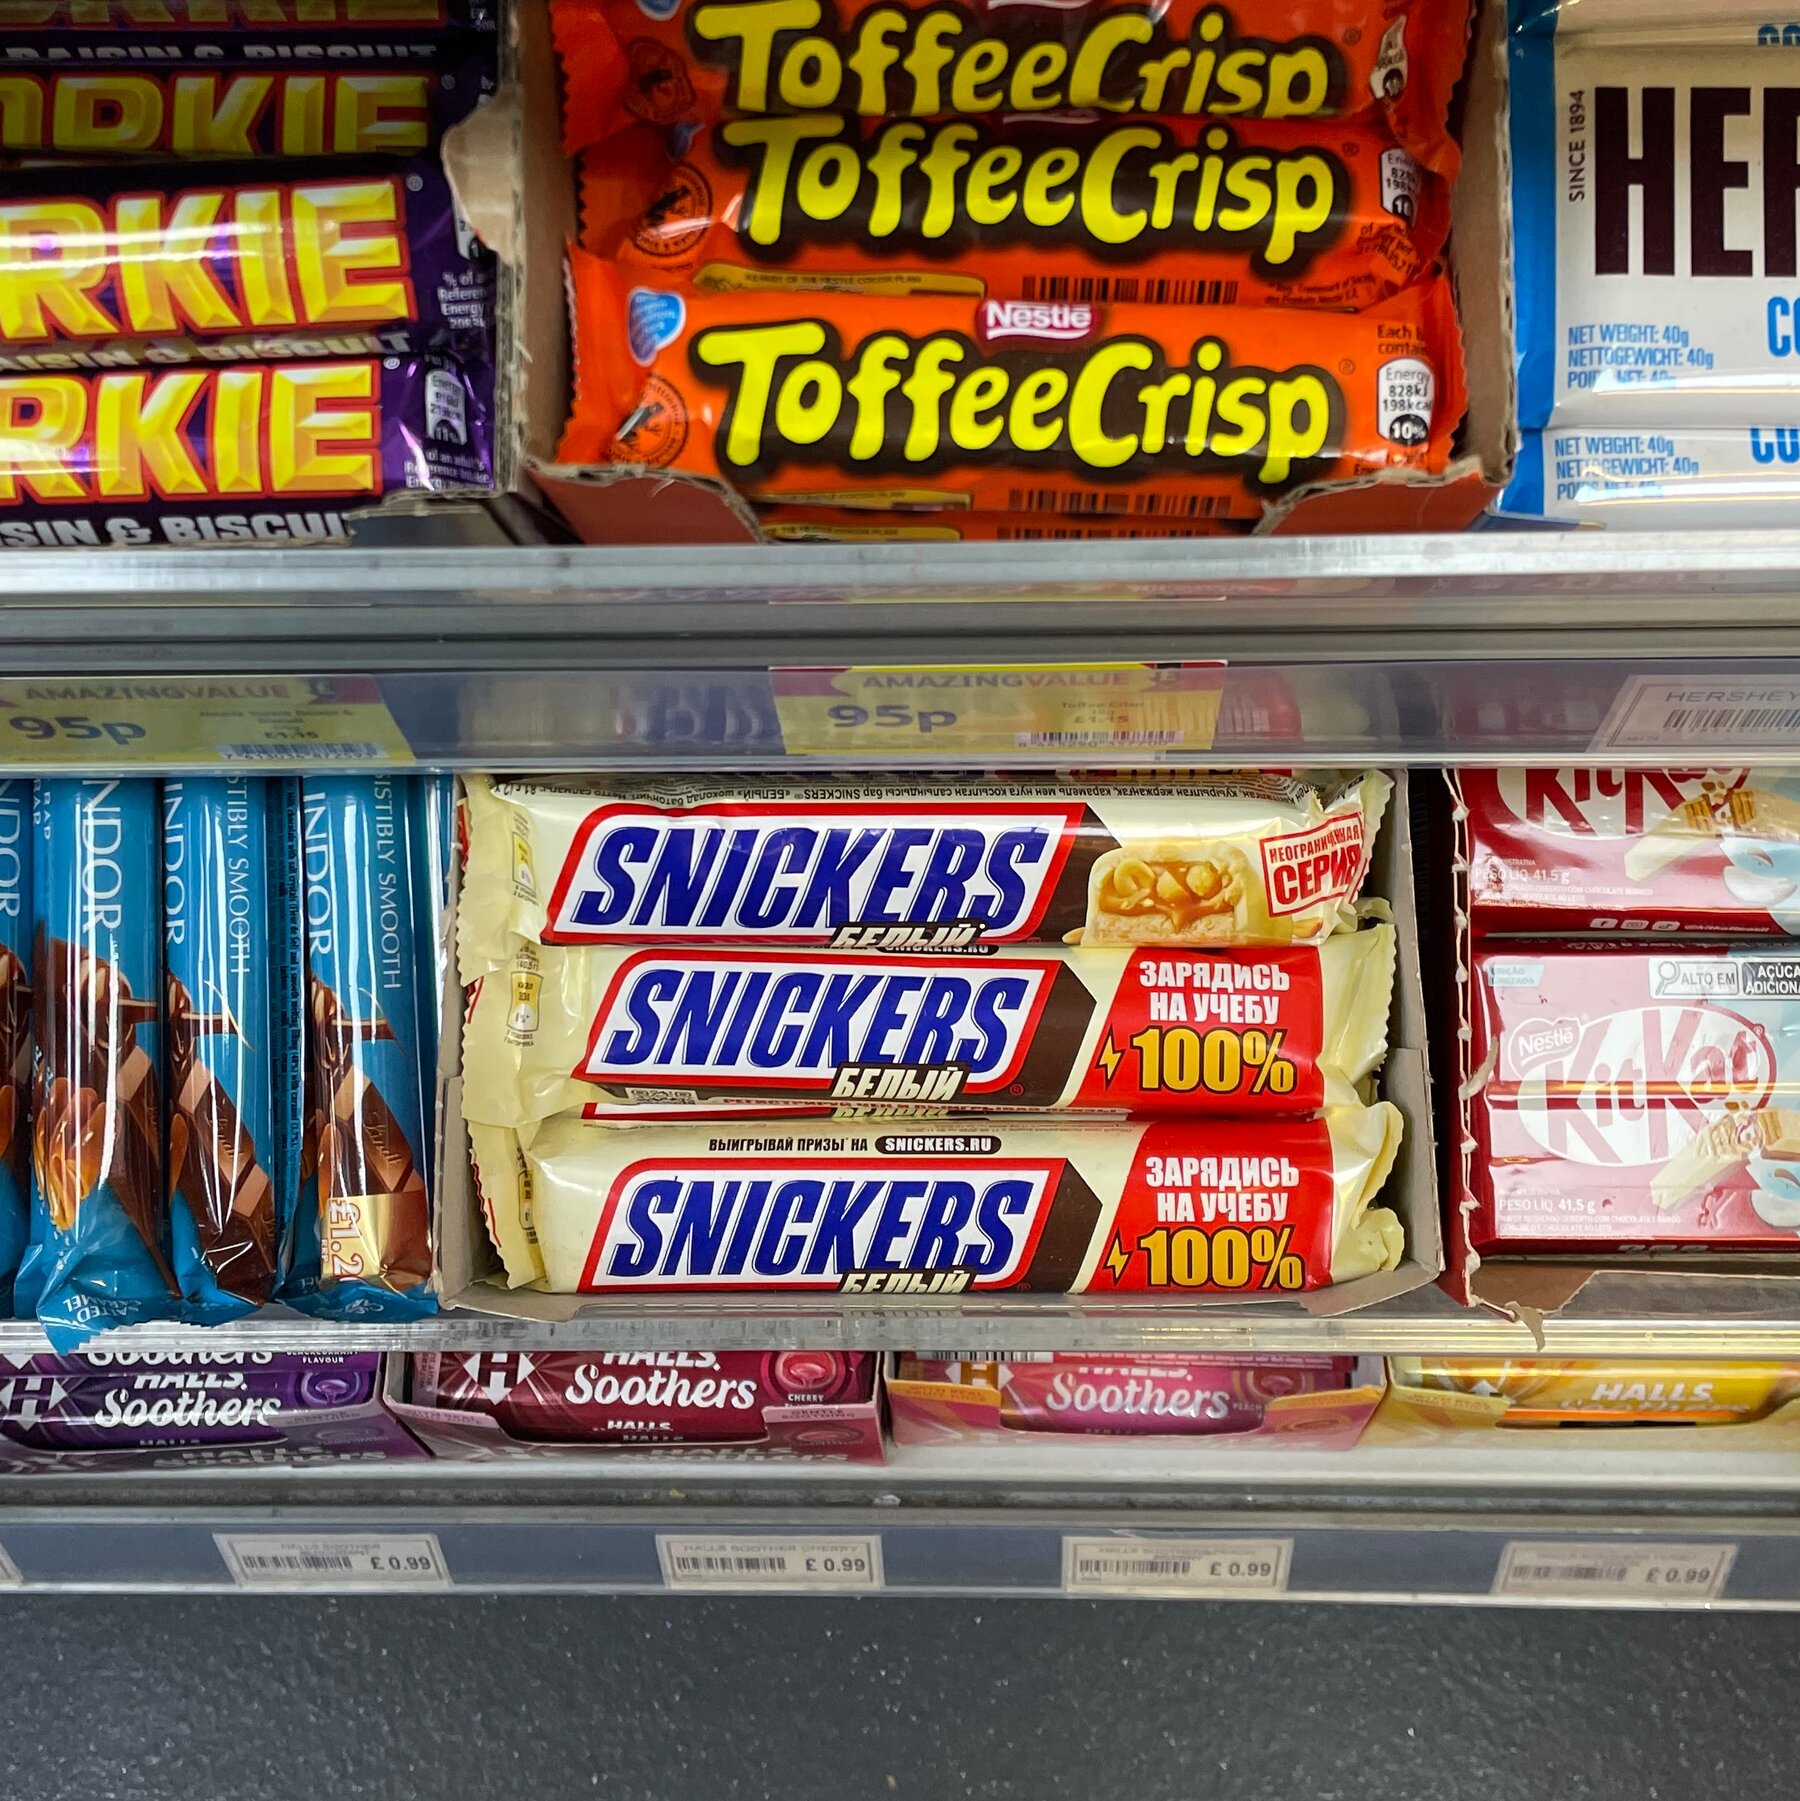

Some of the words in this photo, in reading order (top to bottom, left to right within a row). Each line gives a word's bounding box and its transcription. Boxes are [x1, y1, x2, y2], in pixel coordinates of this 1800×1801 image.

[1569, 90, 1586, 133] 1894
[1569, 140, 1586, 202] SINCE
[1377, 324, 1412, 340] Each
[1567, 325, 1596, 346] NET
[1600, 324, 1659, 344] WEIGHT:
[1662, 326, 1689, 346] 40g
[1687, 350, 1714, 370] 40g
[1386, 367, 1431, 384] Energy
[1391, 420, 1426, 441] 10%
[1555, 437, 1581, 457] NET
[1585, 436, 1645, 456] WEIGHT:
[1647, 437, 1675, 457] 40g
[104, 516, 153, 545] &
[159, 512, 353, 545] BISCUI
[9, 715, 147, 745] 95p
[827, 703, 958, 733] 95p
[863, 788, 884, 799] бар
[1035, 786, 1057, 796] мен
[1058, 785, 1112, 797] карамель
[569, 823, 1051, 931] SNICKERS
[1273, 843, 1361, 906] СЕРИЯ
[1561, 871, 1571, 885] g
[229, 858, 250, 974] SMOOTH
[377, 872, 402, 990] SMOOTH
[1139, 961, 1291, 993] ЗАРЯДИСЬ
[1681, 972, 1713, 985] ALTO
[1718, 973, 1735, 985] EM
[602, 968, 1032, 1073] SNICKERS
[1150, 994, 1187, 1022] НА
[1193, 994, 1281, 1025] УЧЕБУ
[1131, 1026, 1297, 1095] 100%
[836, 1066, 966, 1101] БЕЛЫЙ
[1546, 1009, 1757, 1164] KitKat
[709, 1136, 793, 1152] ВЫИГРЫВАЙ
[851, 1137, 868, 1151] НА
[884, 1136, 992, 1152] SNICKERS.RU
[1145, 1156, 1300, 1189] ЗАРЯДИСЬ
[1157, 1193, 1196, 1223] НА
[1202, 1192, 1289, 1224] УЧЕБУ
[1587, 1200, 1596, 1215] g
[330, 1199, 365, 1283] £1.2
[607, 1179, 1035, 1278] SNICKERS
[1137, 1226, 1305, 1290] 100%
[840, 1267, 968, 1294] БЕЛЫЙ
[302, 1356, 345, 1364] FLAVOUR
[564, 1362, 759, 1410] Soothers
[787, 1393, 825, 1403] CHERRY
[1046, 1373, 1231, 1420] Soothers
[1591, 1383, 1714, 1402] HALLS
[94, 1389, 282, 1428] Soothers
[370, 1556, 385, 1570] £
[388, 1556, 431, 1571] 0.99
[806, 1559, 818, 1572] £
[823, 1558, 866, 1572] 0.99
[1209, 1561, 1222, 1576] £
[1228, 1561, 1272, 1577] 0.99
[1665, 1567, 1711, 1584] 0.99
